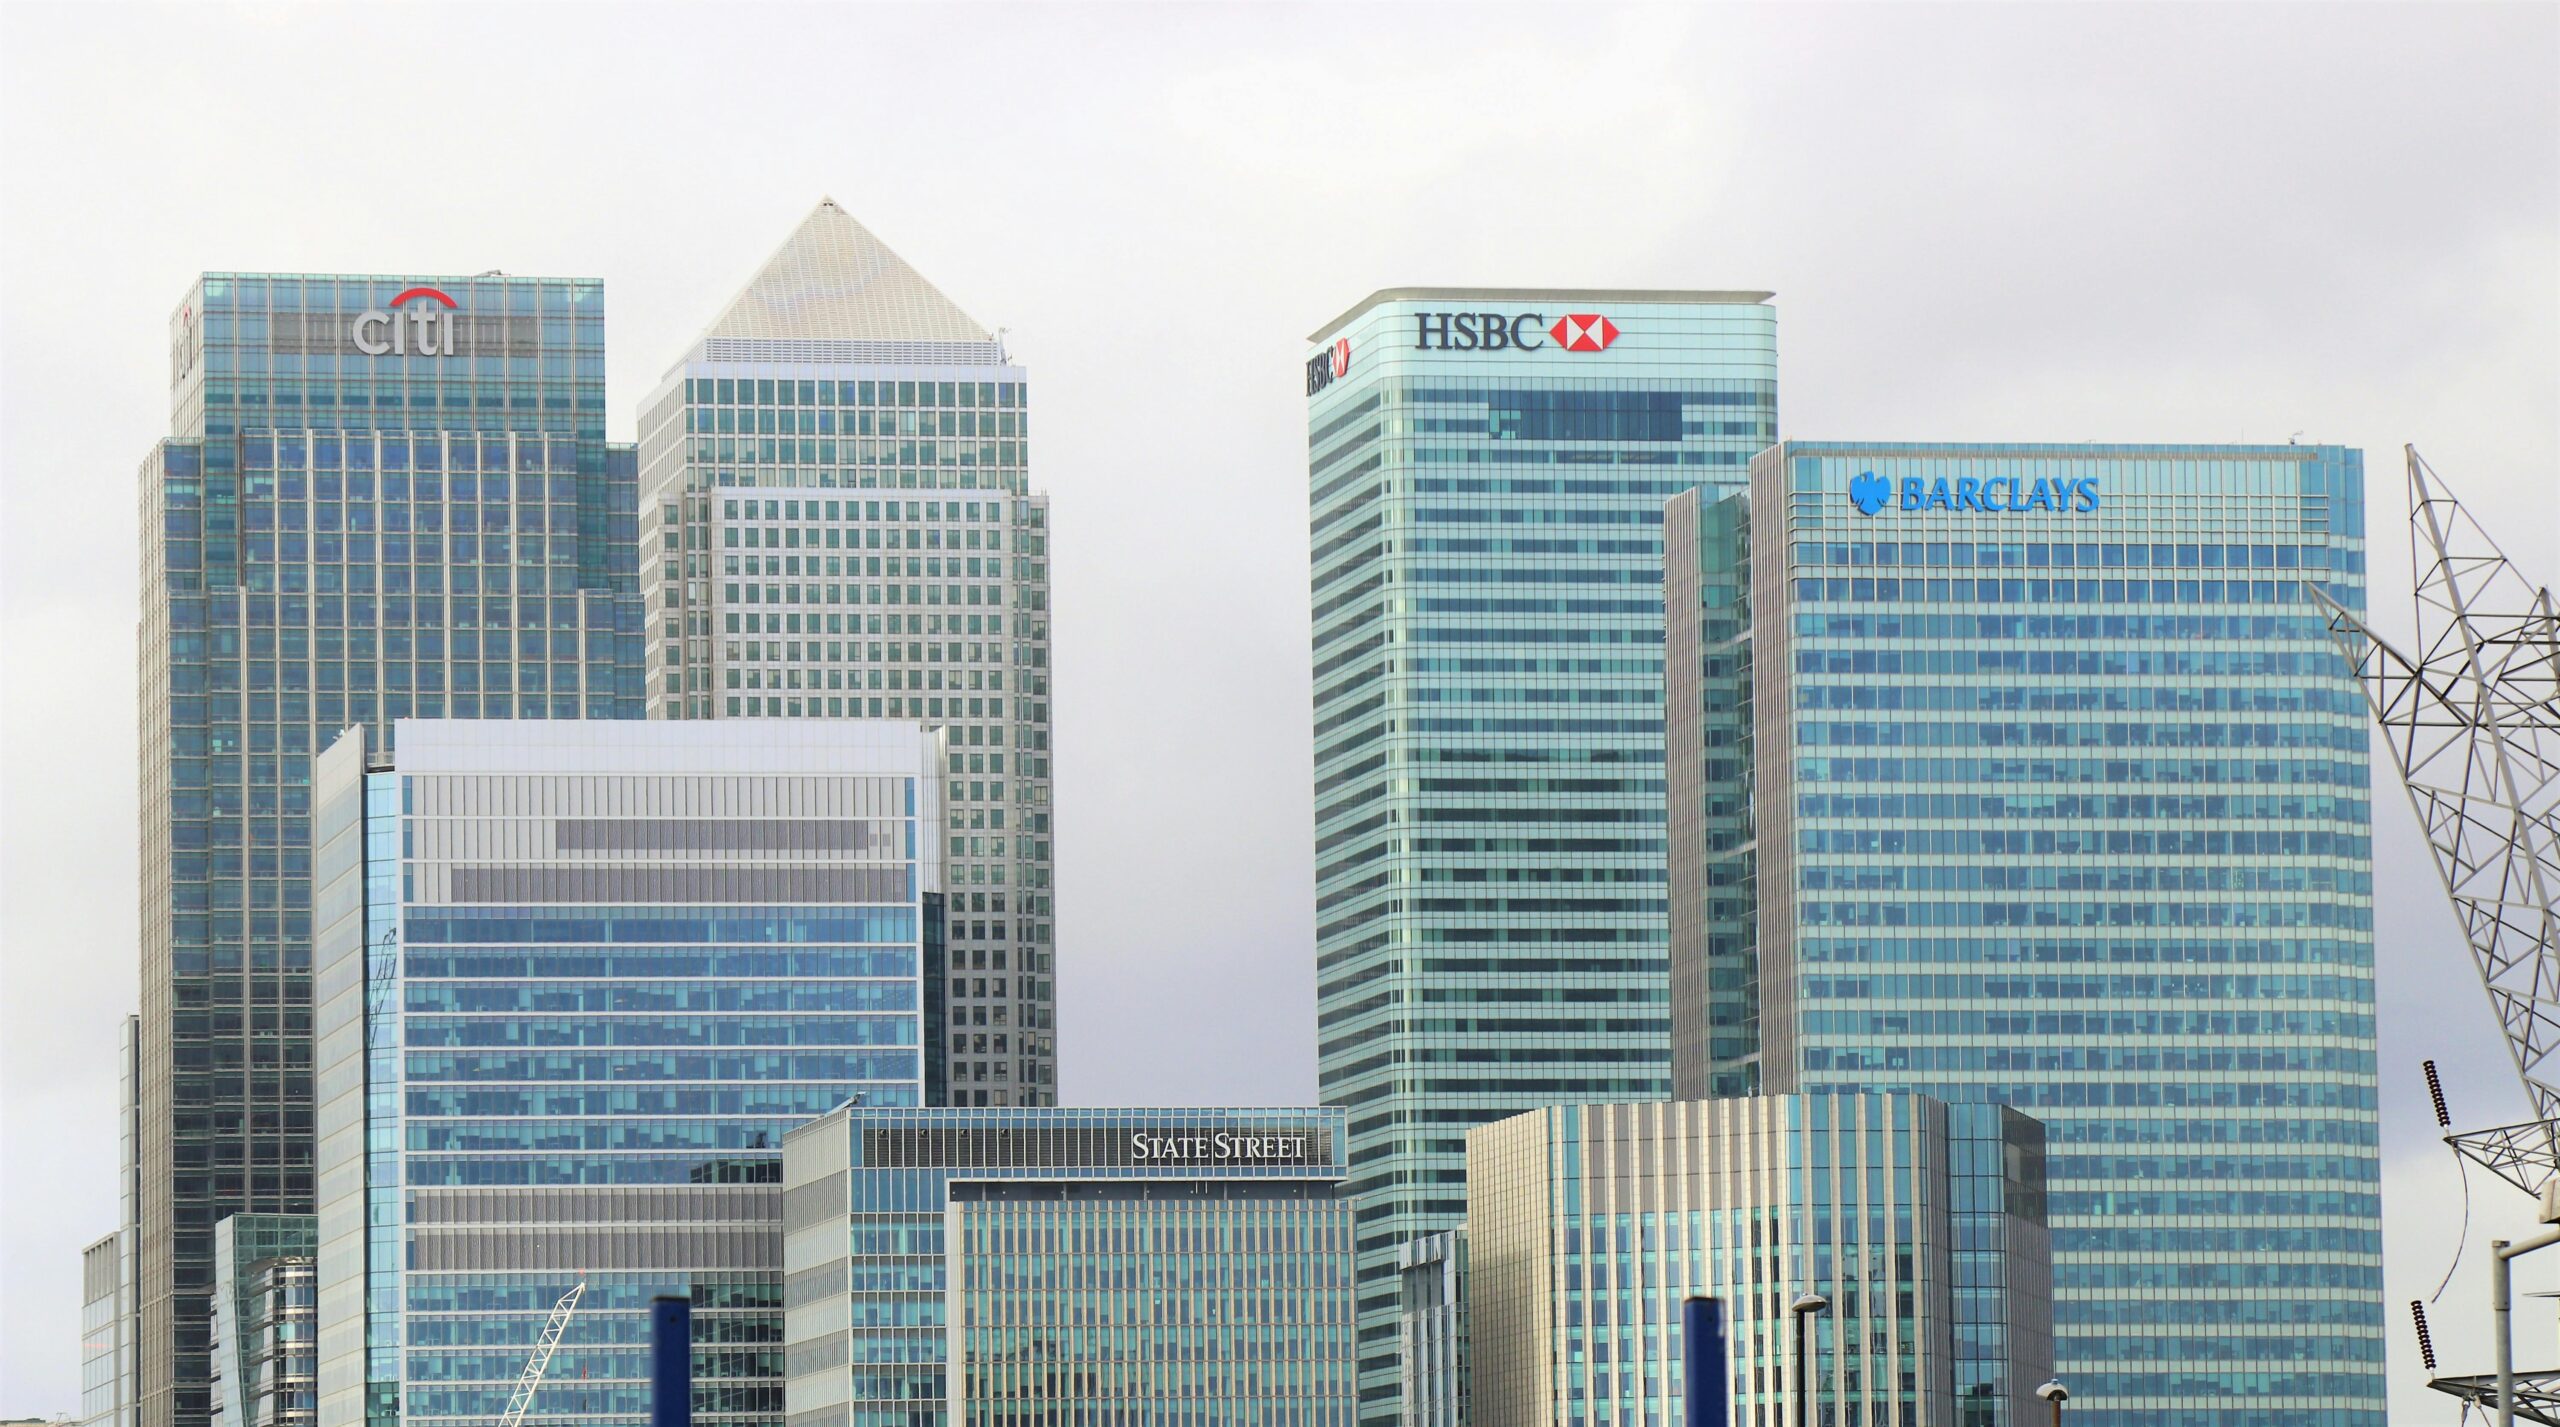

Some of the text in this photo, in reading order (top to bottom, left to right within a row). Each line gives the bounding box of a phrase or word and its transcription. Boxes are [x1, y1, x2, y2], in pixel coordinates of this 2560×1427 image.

[352, 299, 455, 356] citi
[1414, 312, 1544, 352] HSBC
[1306, 345, 1334, 397] HSBC
[1901, 476, 2100, 512] BARCLAYS
[1132, 1133, 1306, 1159] STATE STREET
